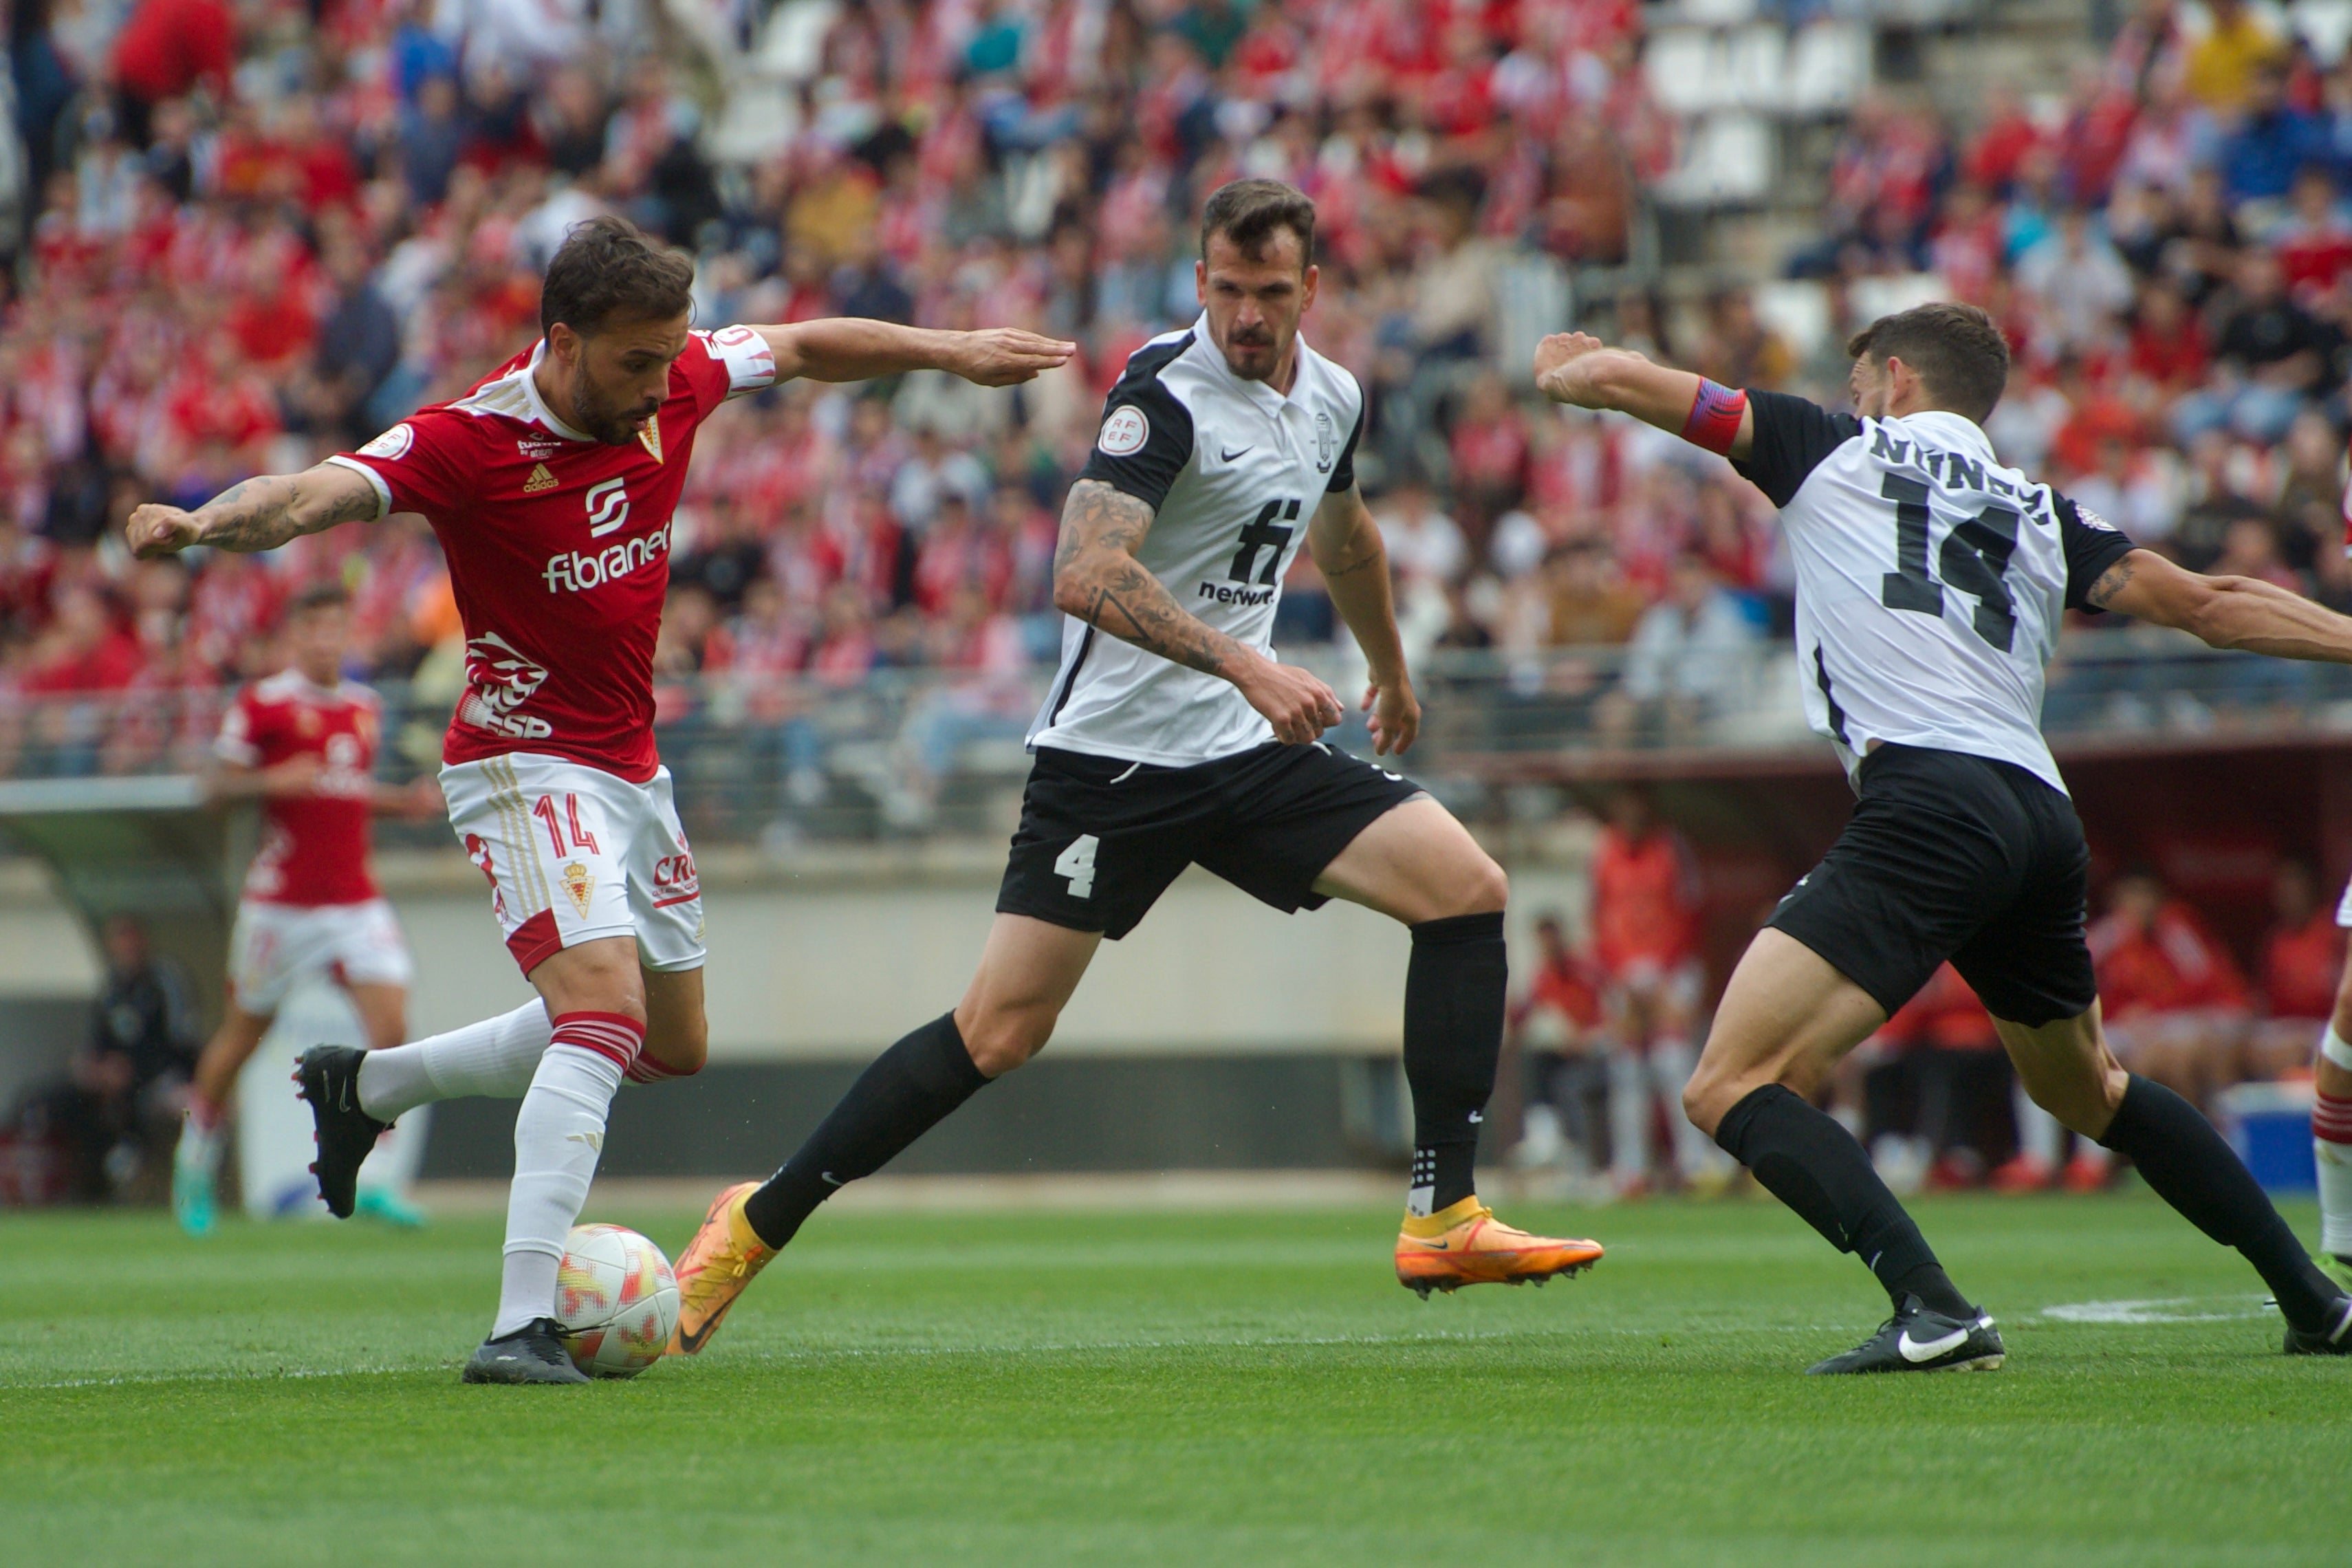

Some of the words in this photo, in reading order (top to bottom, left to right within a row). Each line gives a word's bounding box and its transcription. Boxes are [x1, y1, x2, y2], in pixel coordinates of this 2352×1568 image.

[523, 479, 559, 492] adidas
[533, 792, 600, 859] 14
[1054, 833, 1100, 899] 4
